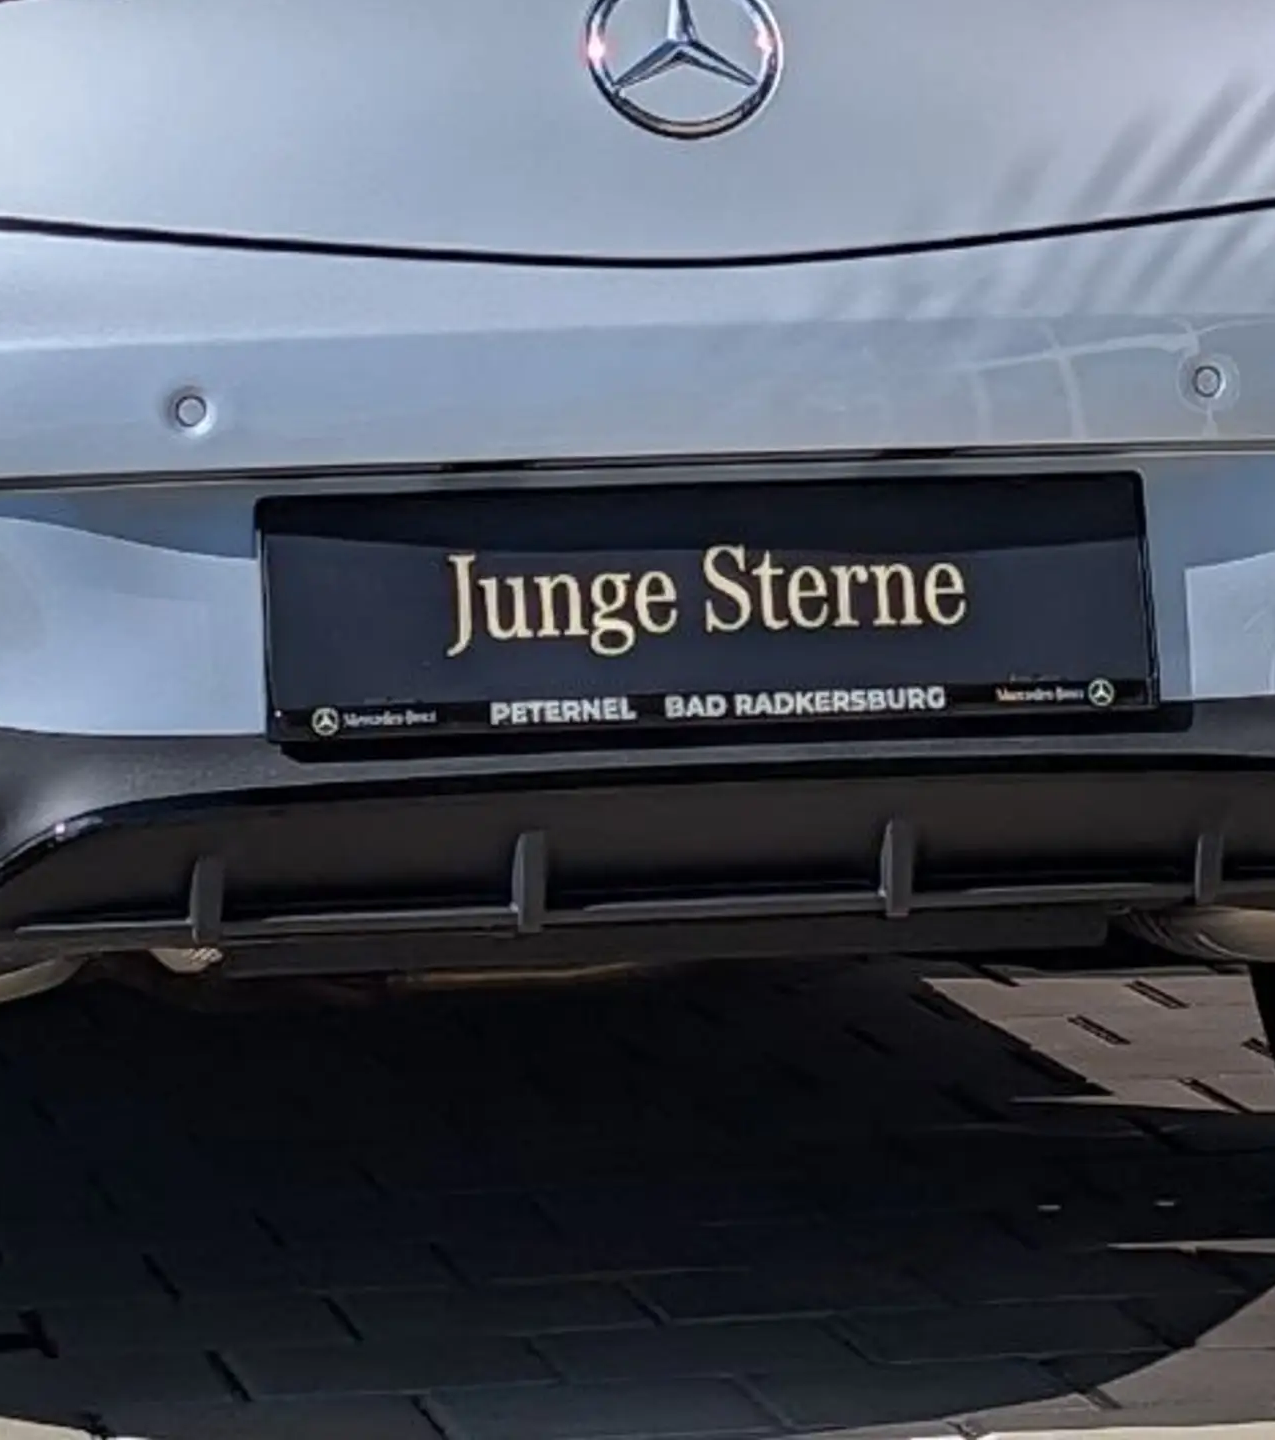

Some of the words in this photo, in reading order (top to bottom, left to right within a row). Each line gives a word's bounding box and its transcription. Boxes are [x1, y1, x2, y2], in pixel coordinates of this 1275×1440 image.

[446, 554, 678, 656] Junge
[704, 544, 967, 632] Sterne
[490, 697, 636, 726] PETERNEL
[664, 694, 726, 719] BAD
[734, 686, 945, 717] RADKERSBURG
